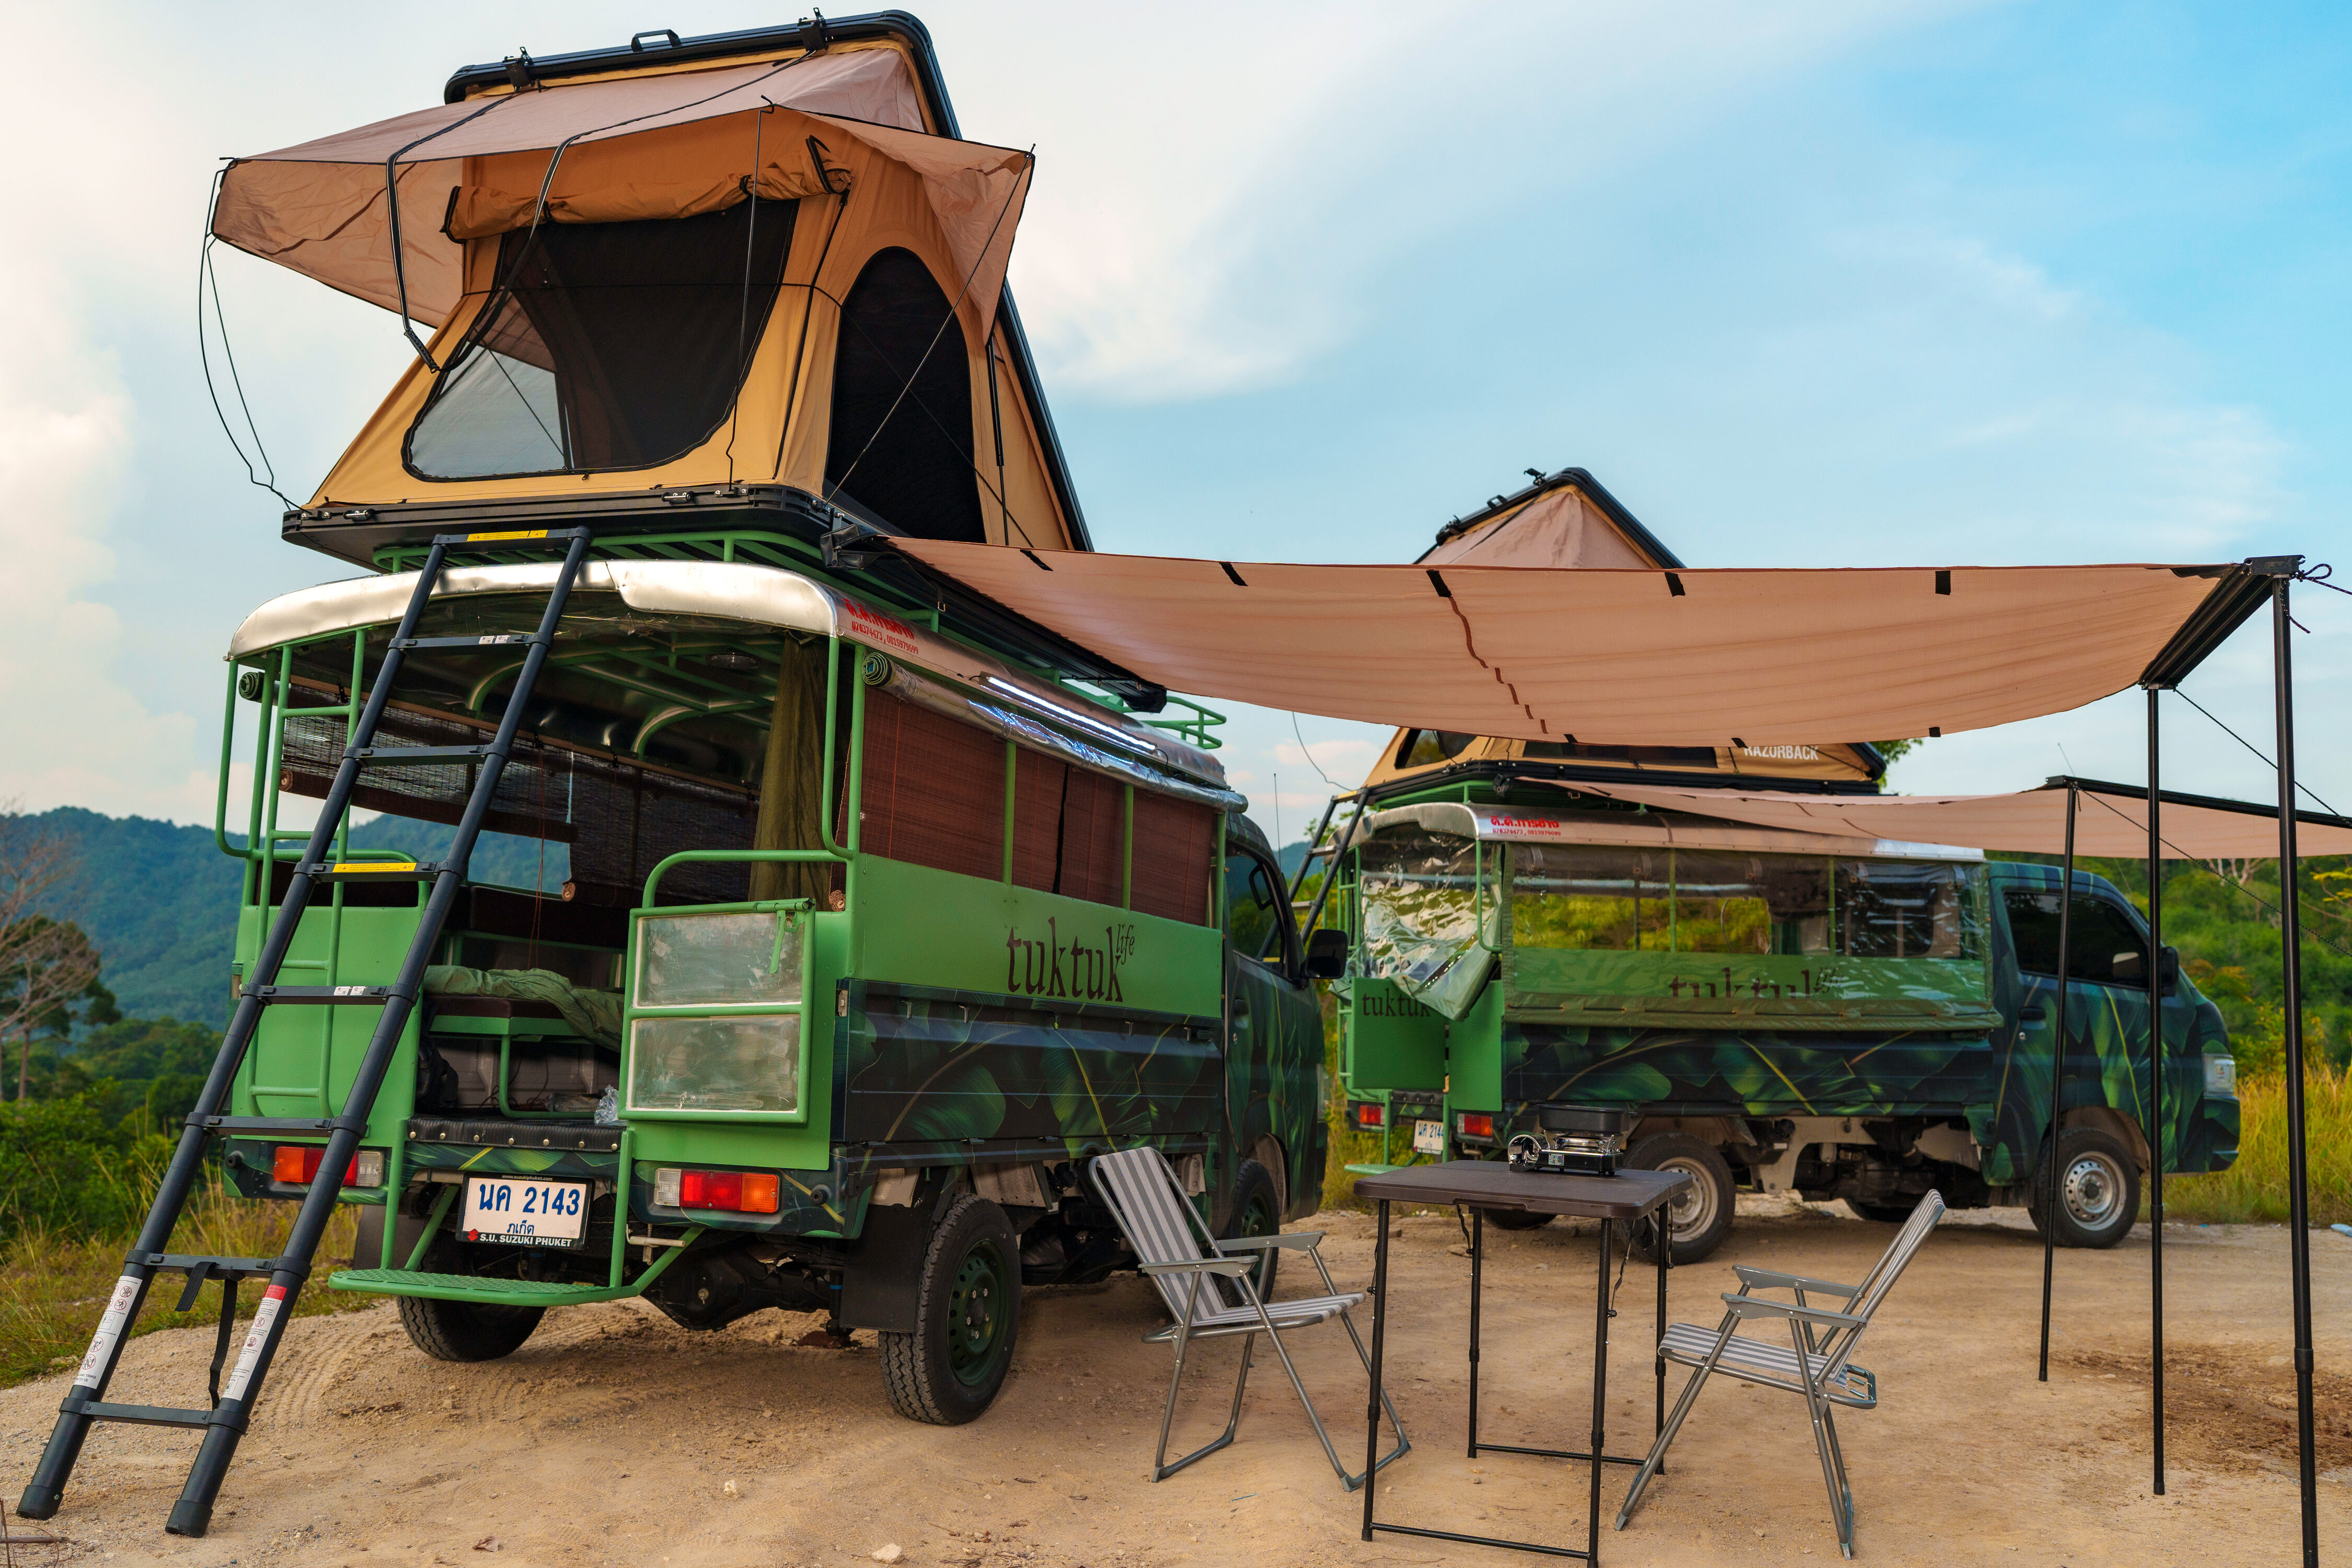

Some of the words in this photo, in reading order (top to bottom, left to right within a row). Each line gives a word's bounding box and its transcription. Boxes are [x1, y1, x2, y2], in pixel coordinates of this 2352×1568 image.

[1007, 916, 1123, 1002] tuktuk
[1116, 924, 1135, 965] life
[479, 1184, 511, 1211] นค
[523, 1186, 580, 1215] 2143
[507, 1220, 534, 1235] ภเก็ต
[480, 1233, 498, 1242] S.U.
[500, 1235, 533, 1244] SUZUKI
[536, 1238, 572, 1247] PHUKET
